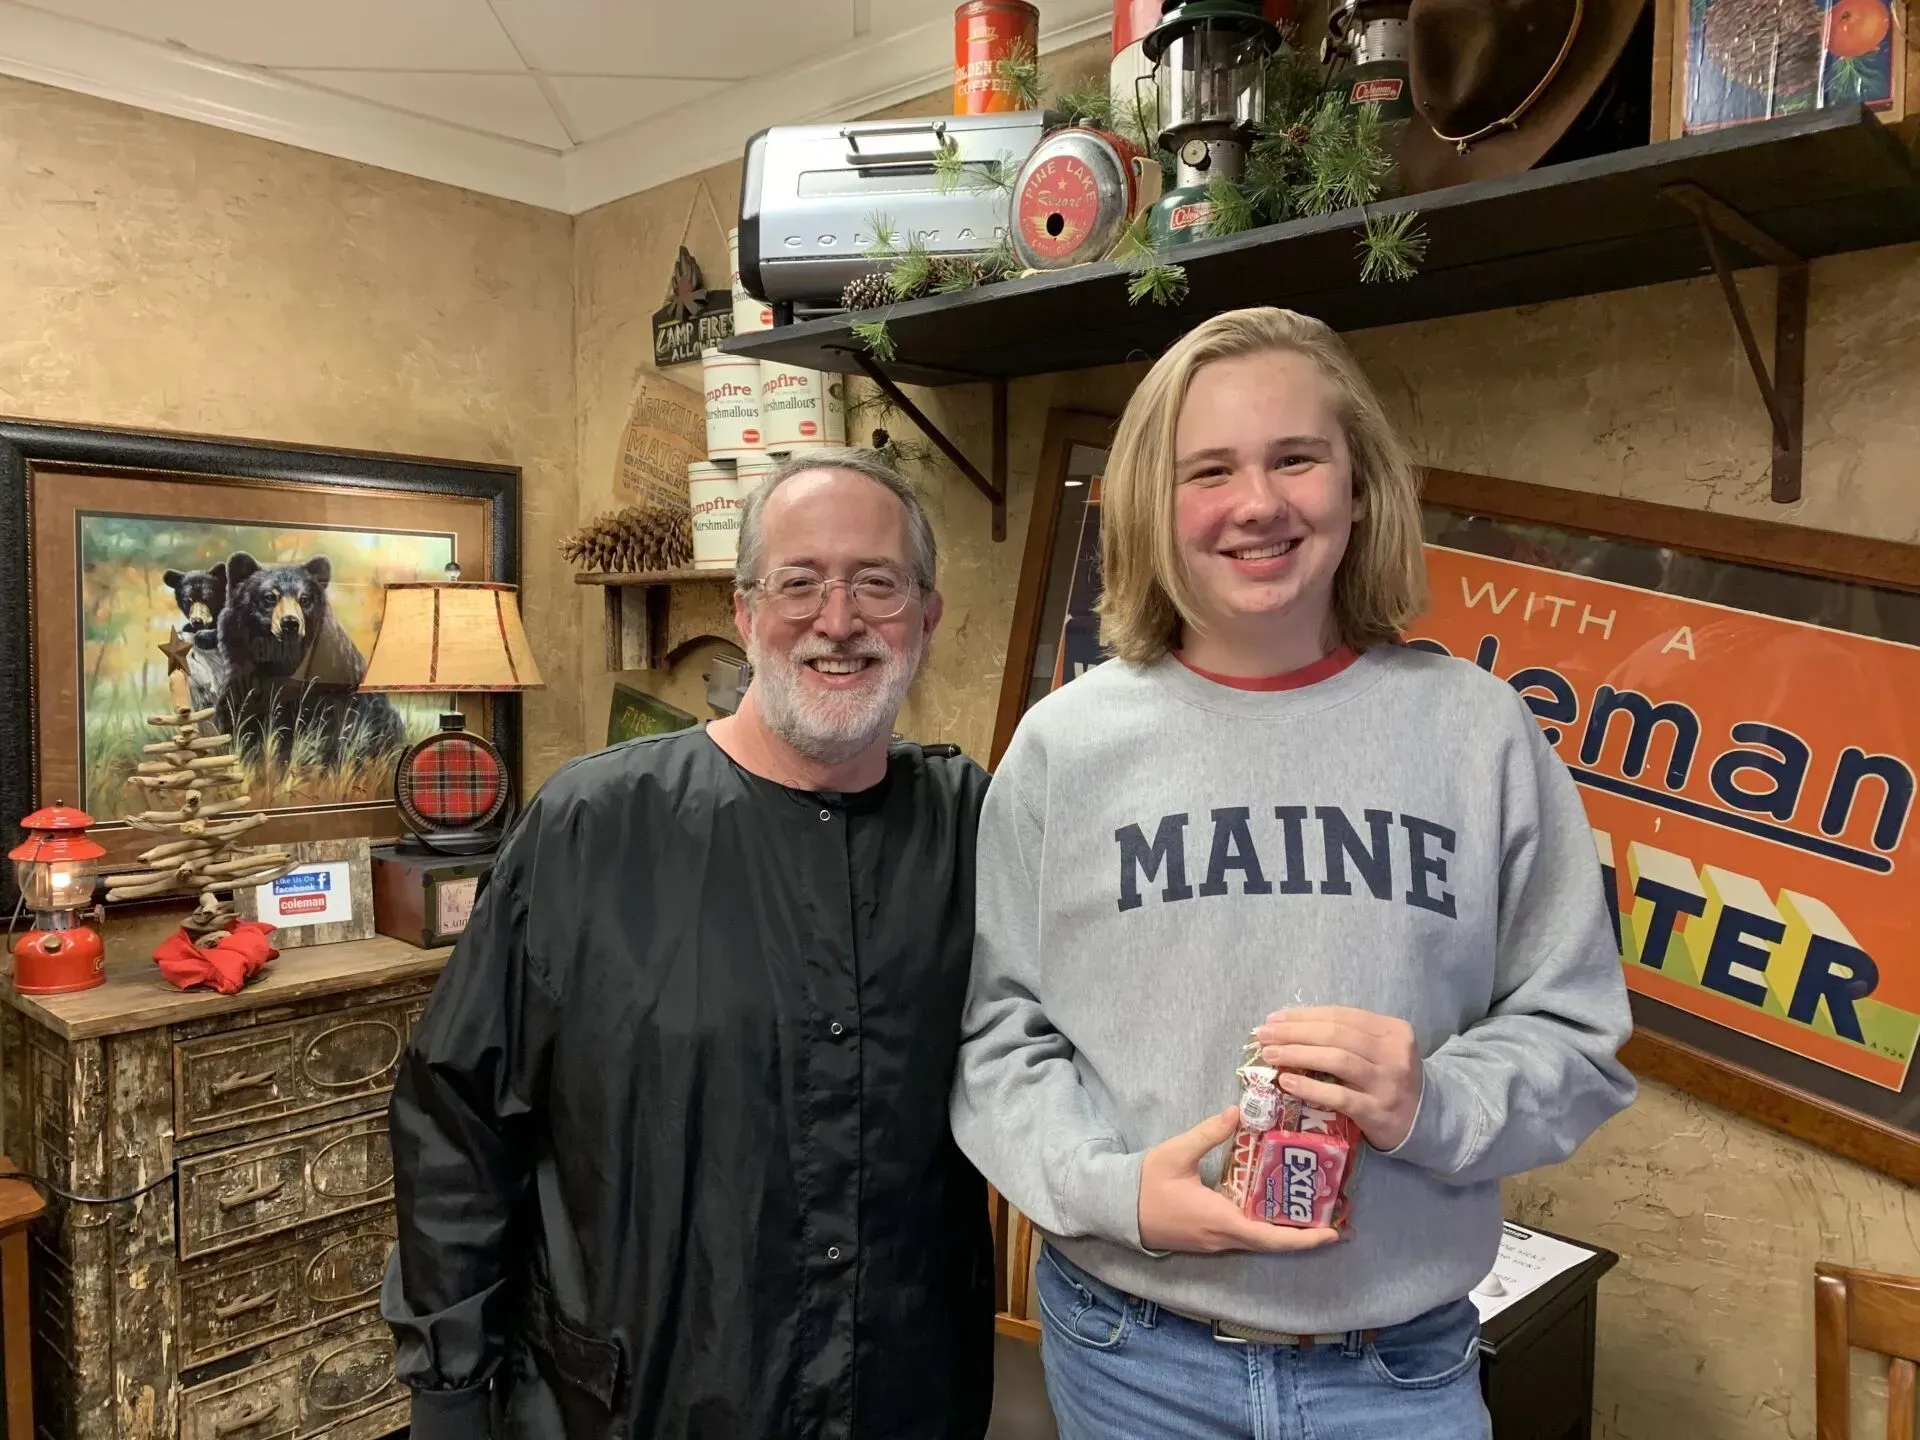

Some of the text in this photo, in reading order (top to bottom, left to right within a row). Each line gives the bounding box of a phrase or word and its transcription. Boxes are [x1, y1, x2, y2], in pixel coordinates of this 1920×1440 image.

[1026, 160, 1096, 202] PINE LAKE
[656, 322, 694, 354] CAMP
[698, 313, 735, 341] FIRES
[705, 383, 752, 401] mpfire
[763, 374, 808, 393] mpfire
[706, 406, 759, 420] arshmallows
[764, 397, 816, 413] arshmallows
[692, 497, 745, 516] ampfire
[694, 518, 740, 532] Marshmallo
[1460, 576, 1697, 660] WITH A
[1406, 634, 1917, 852] eman
[1114, 805, 1458, 921] MAINE
[276, 883, 316, 893] facebook
[281, 897, 325, 910] coleman
[1600, 848, 1879, 1045] TER
[1284, 1147, 1318, 1223] Extra
